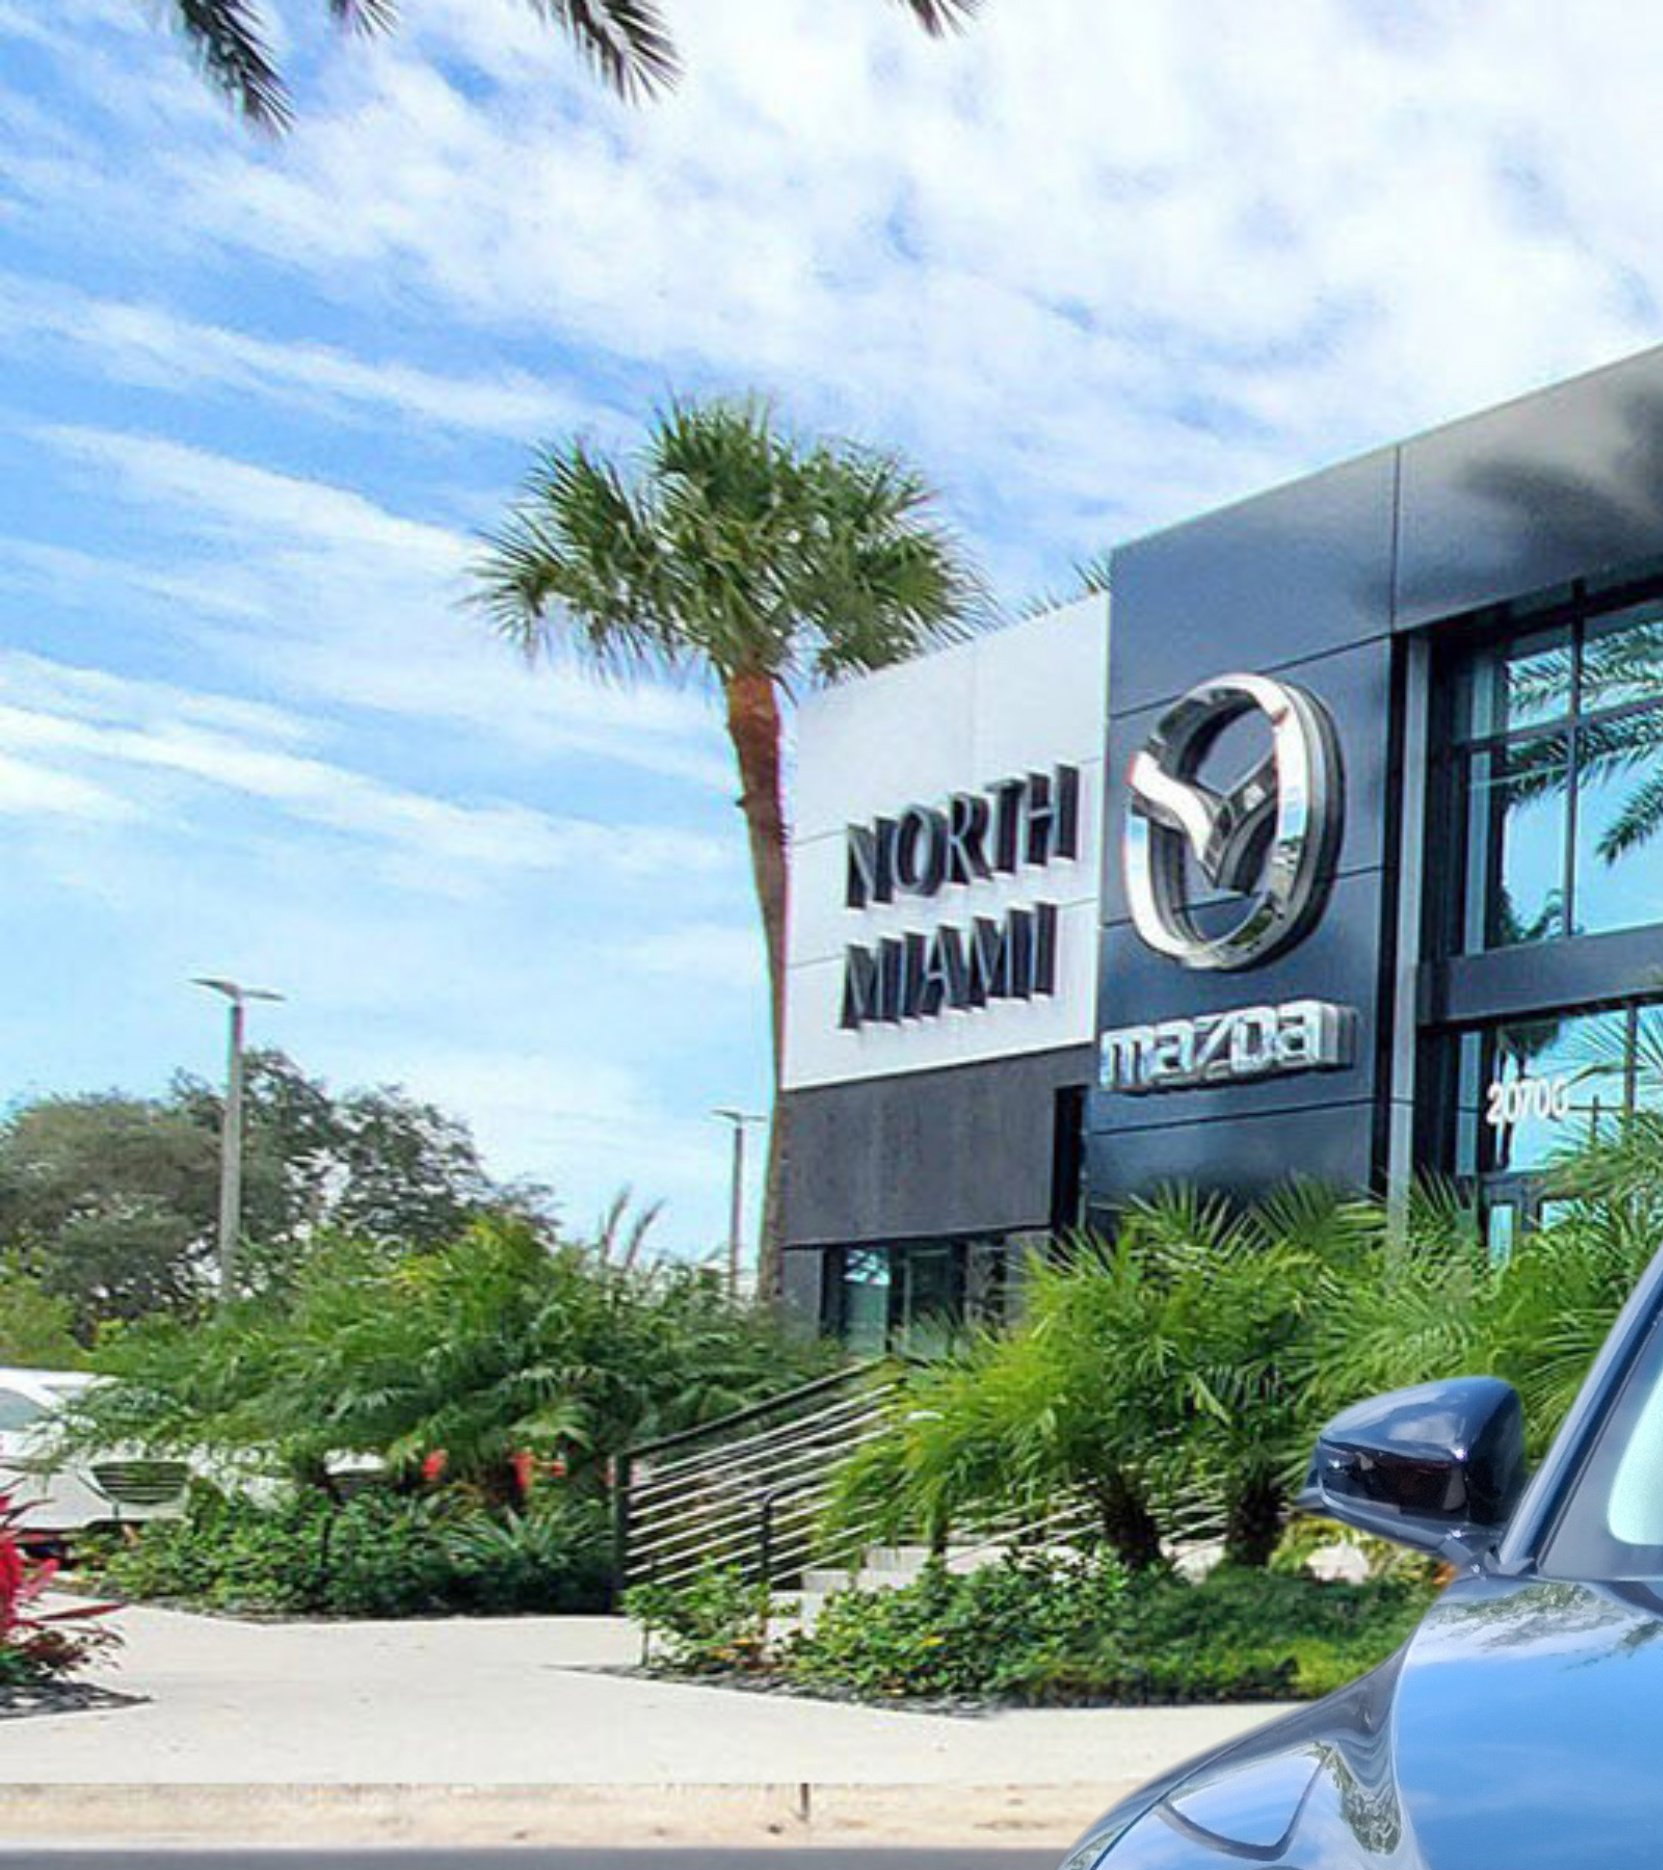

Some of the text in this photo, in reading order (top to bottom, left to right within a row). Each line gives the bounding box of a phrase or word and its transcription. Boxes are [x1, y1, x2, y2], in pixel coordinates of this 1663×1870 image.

[846, 763, 1080, 910] NORTH
[839, 902, 1058, 1030] MIAMI
[1099, 1000, 1345, 1092] mazda
